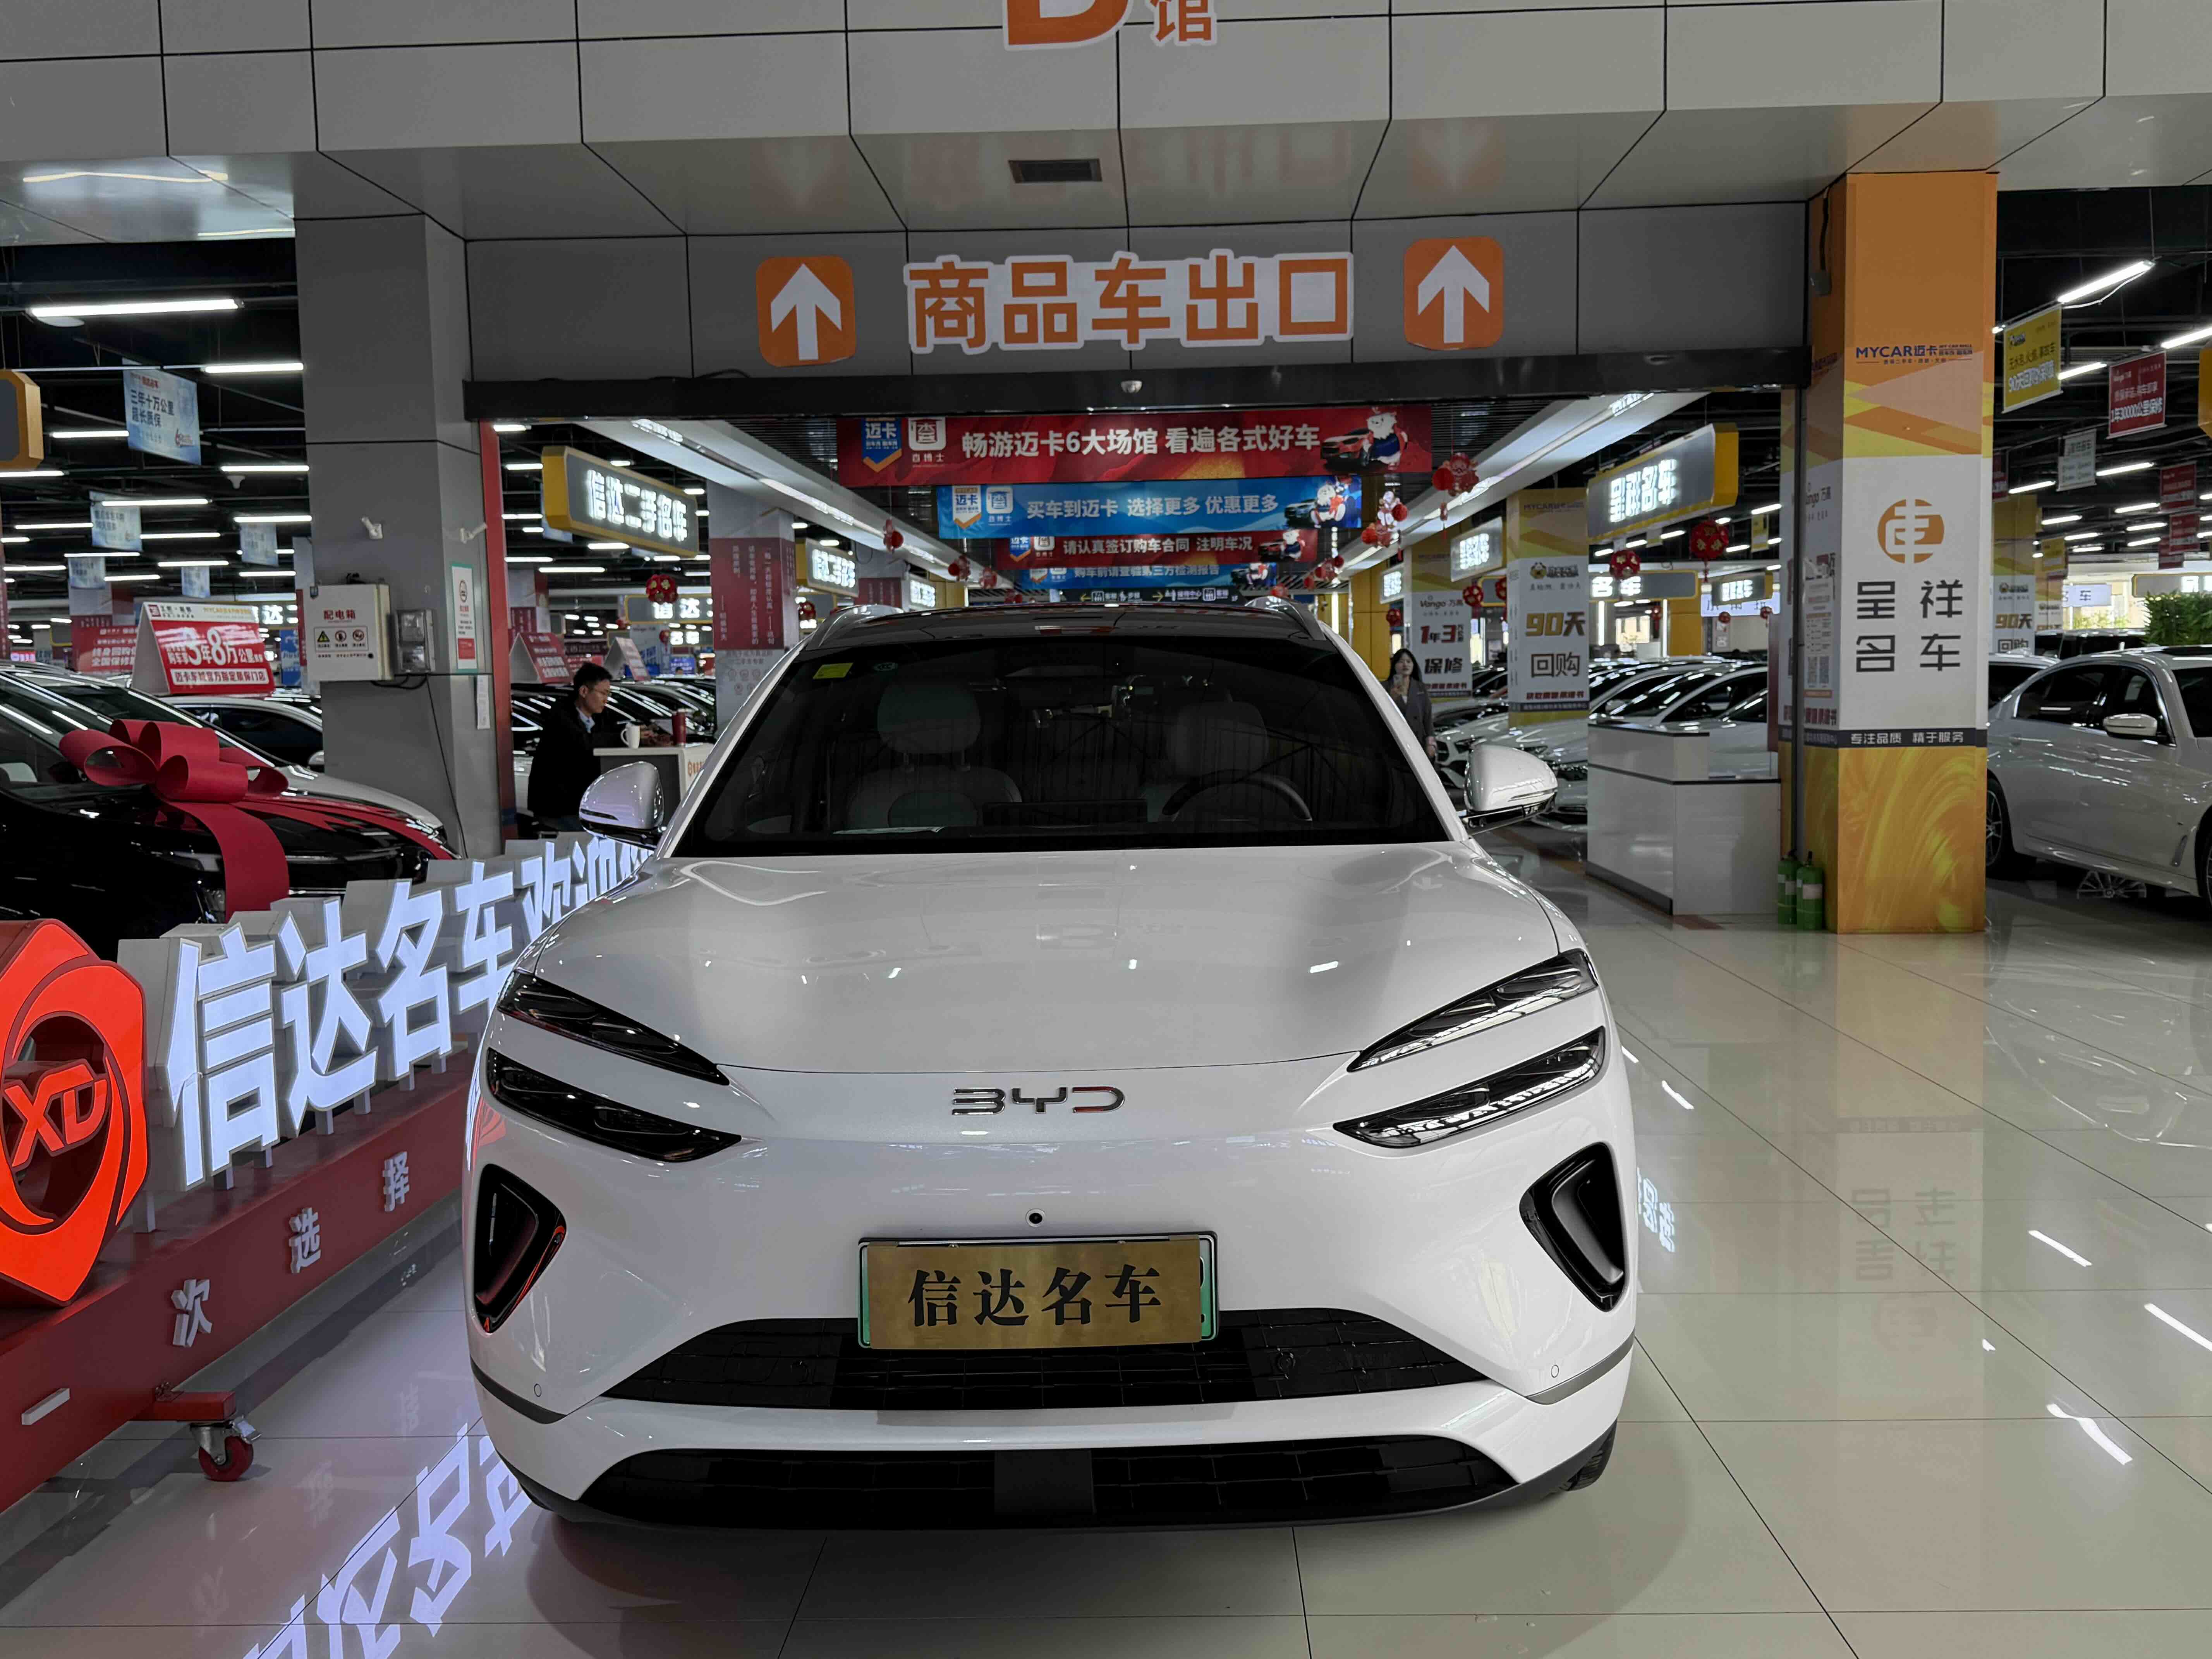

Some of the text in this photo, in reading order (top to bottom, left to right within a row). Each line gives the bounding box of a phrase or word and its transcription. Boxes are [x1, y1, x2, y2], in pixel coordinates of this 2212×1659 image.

[908, 255, 1348, 350] 商品车出口
[1856, 345, 1937, 359] MYCAR迈卡
[866, 422, 896, 438] 迈卡
[962, 424, 1320, 458] 畅游迈卡6大场馆 看遍各式好车
[956, 494, 977, 505] 迈卡
[1027, 494, 1278, 519] 买车到迈卡 选择更多 优惠更多
[1064, 536, 1252, 555] 请认真签订购车合同 注明车况
[1857, 580, 1963, 620] 呈祥
[323, 609, 356, 620] 配电箱
[1525, 611, 1585, 637] 90天
[1995, 613, 2032, 629] 90天
[1425, 657, 1463, 674] 保修
[1531, 653, 1580, 678] 回购
[1856, 633, 1961, 673] 名车
[1850, 732, 1964, 744] 专注品质 精于服务
[952, 1086, 1125, 1115] BYD
[908, 1264, 1161, 1326] 信达名车
